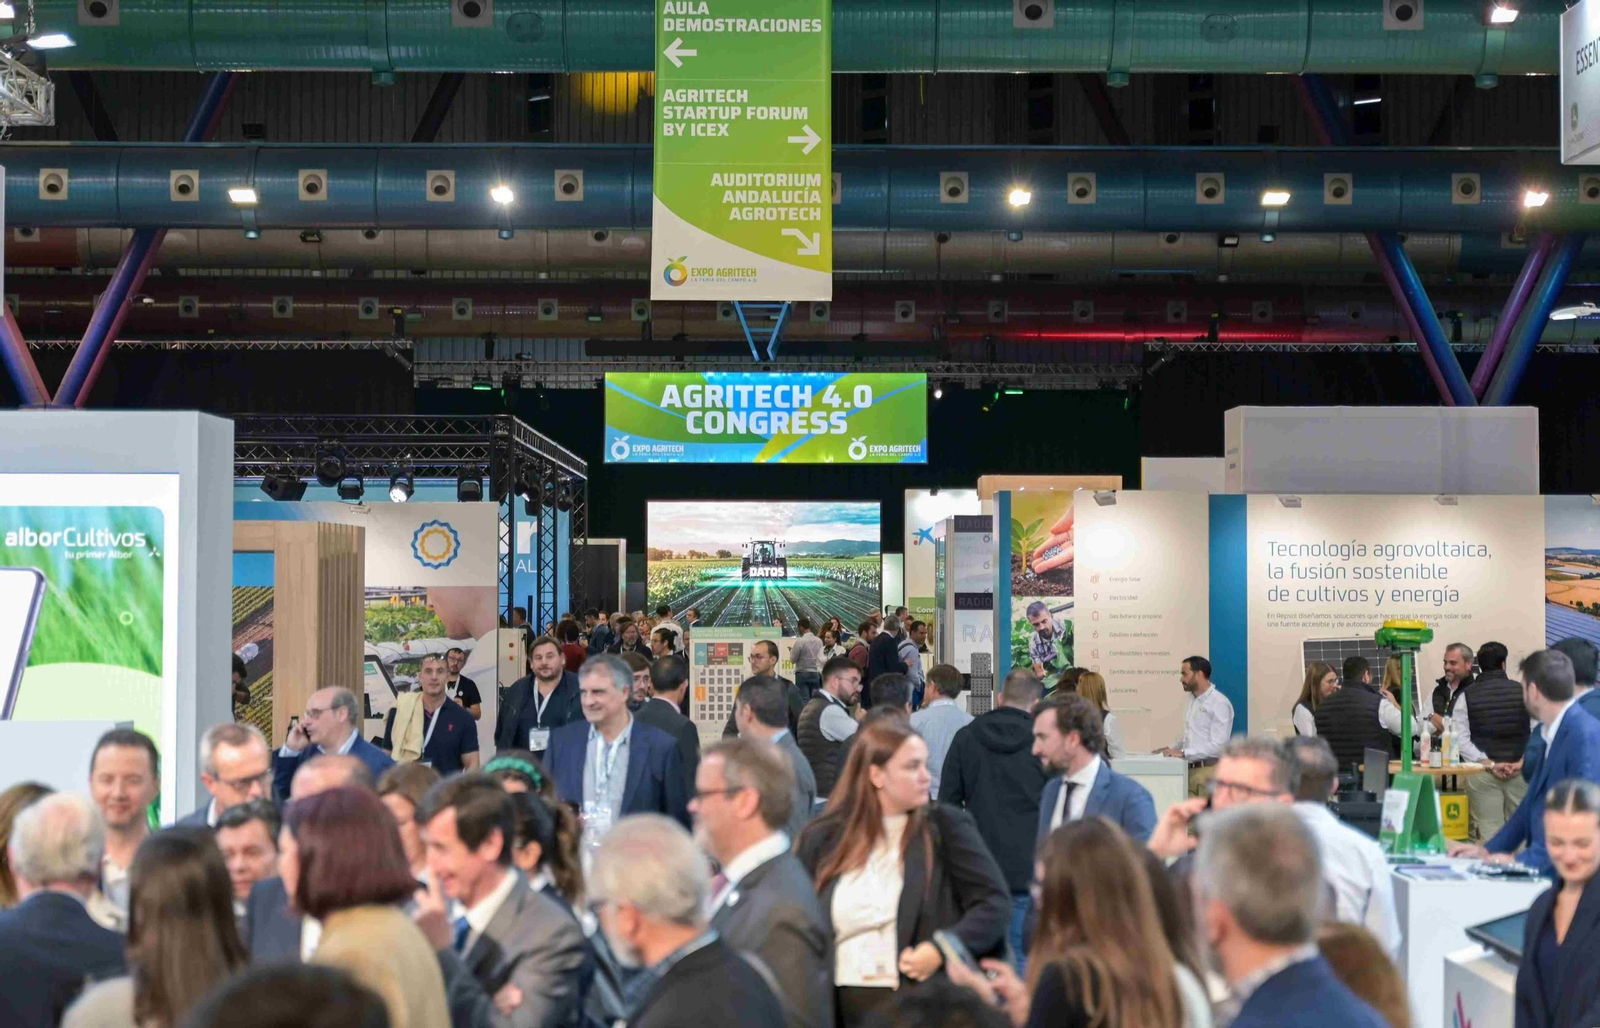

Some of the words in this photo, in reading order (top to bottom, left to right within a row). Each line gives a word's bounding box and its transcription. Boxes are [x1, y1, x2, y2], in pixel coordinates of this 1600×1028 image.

[663, 1, 709, 14] AULA
[664, 18, 822, 32] DEMOSTRACIONES
[1576, 37, 1600, 76] ESSEN
[663, 89, 748, 102] AGRITECH
[663, 106, 742, 120] STARTUP
[746, 106, 808, 120] FORUM
[663, 124, 686, 136] BY
[690, 124, 729, 136] ICEX
[711, 174, 821, 186] AUDITORIUM
[722, 188, 821, 204] ANDALUCÍA
[729, 208, 821, 220] AGROTECH
[691, 268, 713, 276] EXPO
[716, 268, 756, 276] AGRITECH
[660, 385, 812, 408] AGRITECH
[822, 385, 873, 408] 4.0
[686, 411, 848, 435] CONGRESS
[5, 527, 146, 547] alborCultivos
[76, 551, 106, 560] primer
[1267, 540, 1367, 561] Tecnología
[1373, 540, 1492, 561] agrovoltaica,
[749, 567, 784, 577] DATOS
[1268, 563, 1284, 580] la
[1290, 562, 1346, 580] fusión
[1353, 563, 1448, 580] sostenible
[959, 598, 992, 606] RADIO
[1268, 586, 1290, 602] de
[1296, 586, 1368, 602] cultivos
[1374, 590, 1385, 606] y
[1391, 585, 1460, 606] energía
